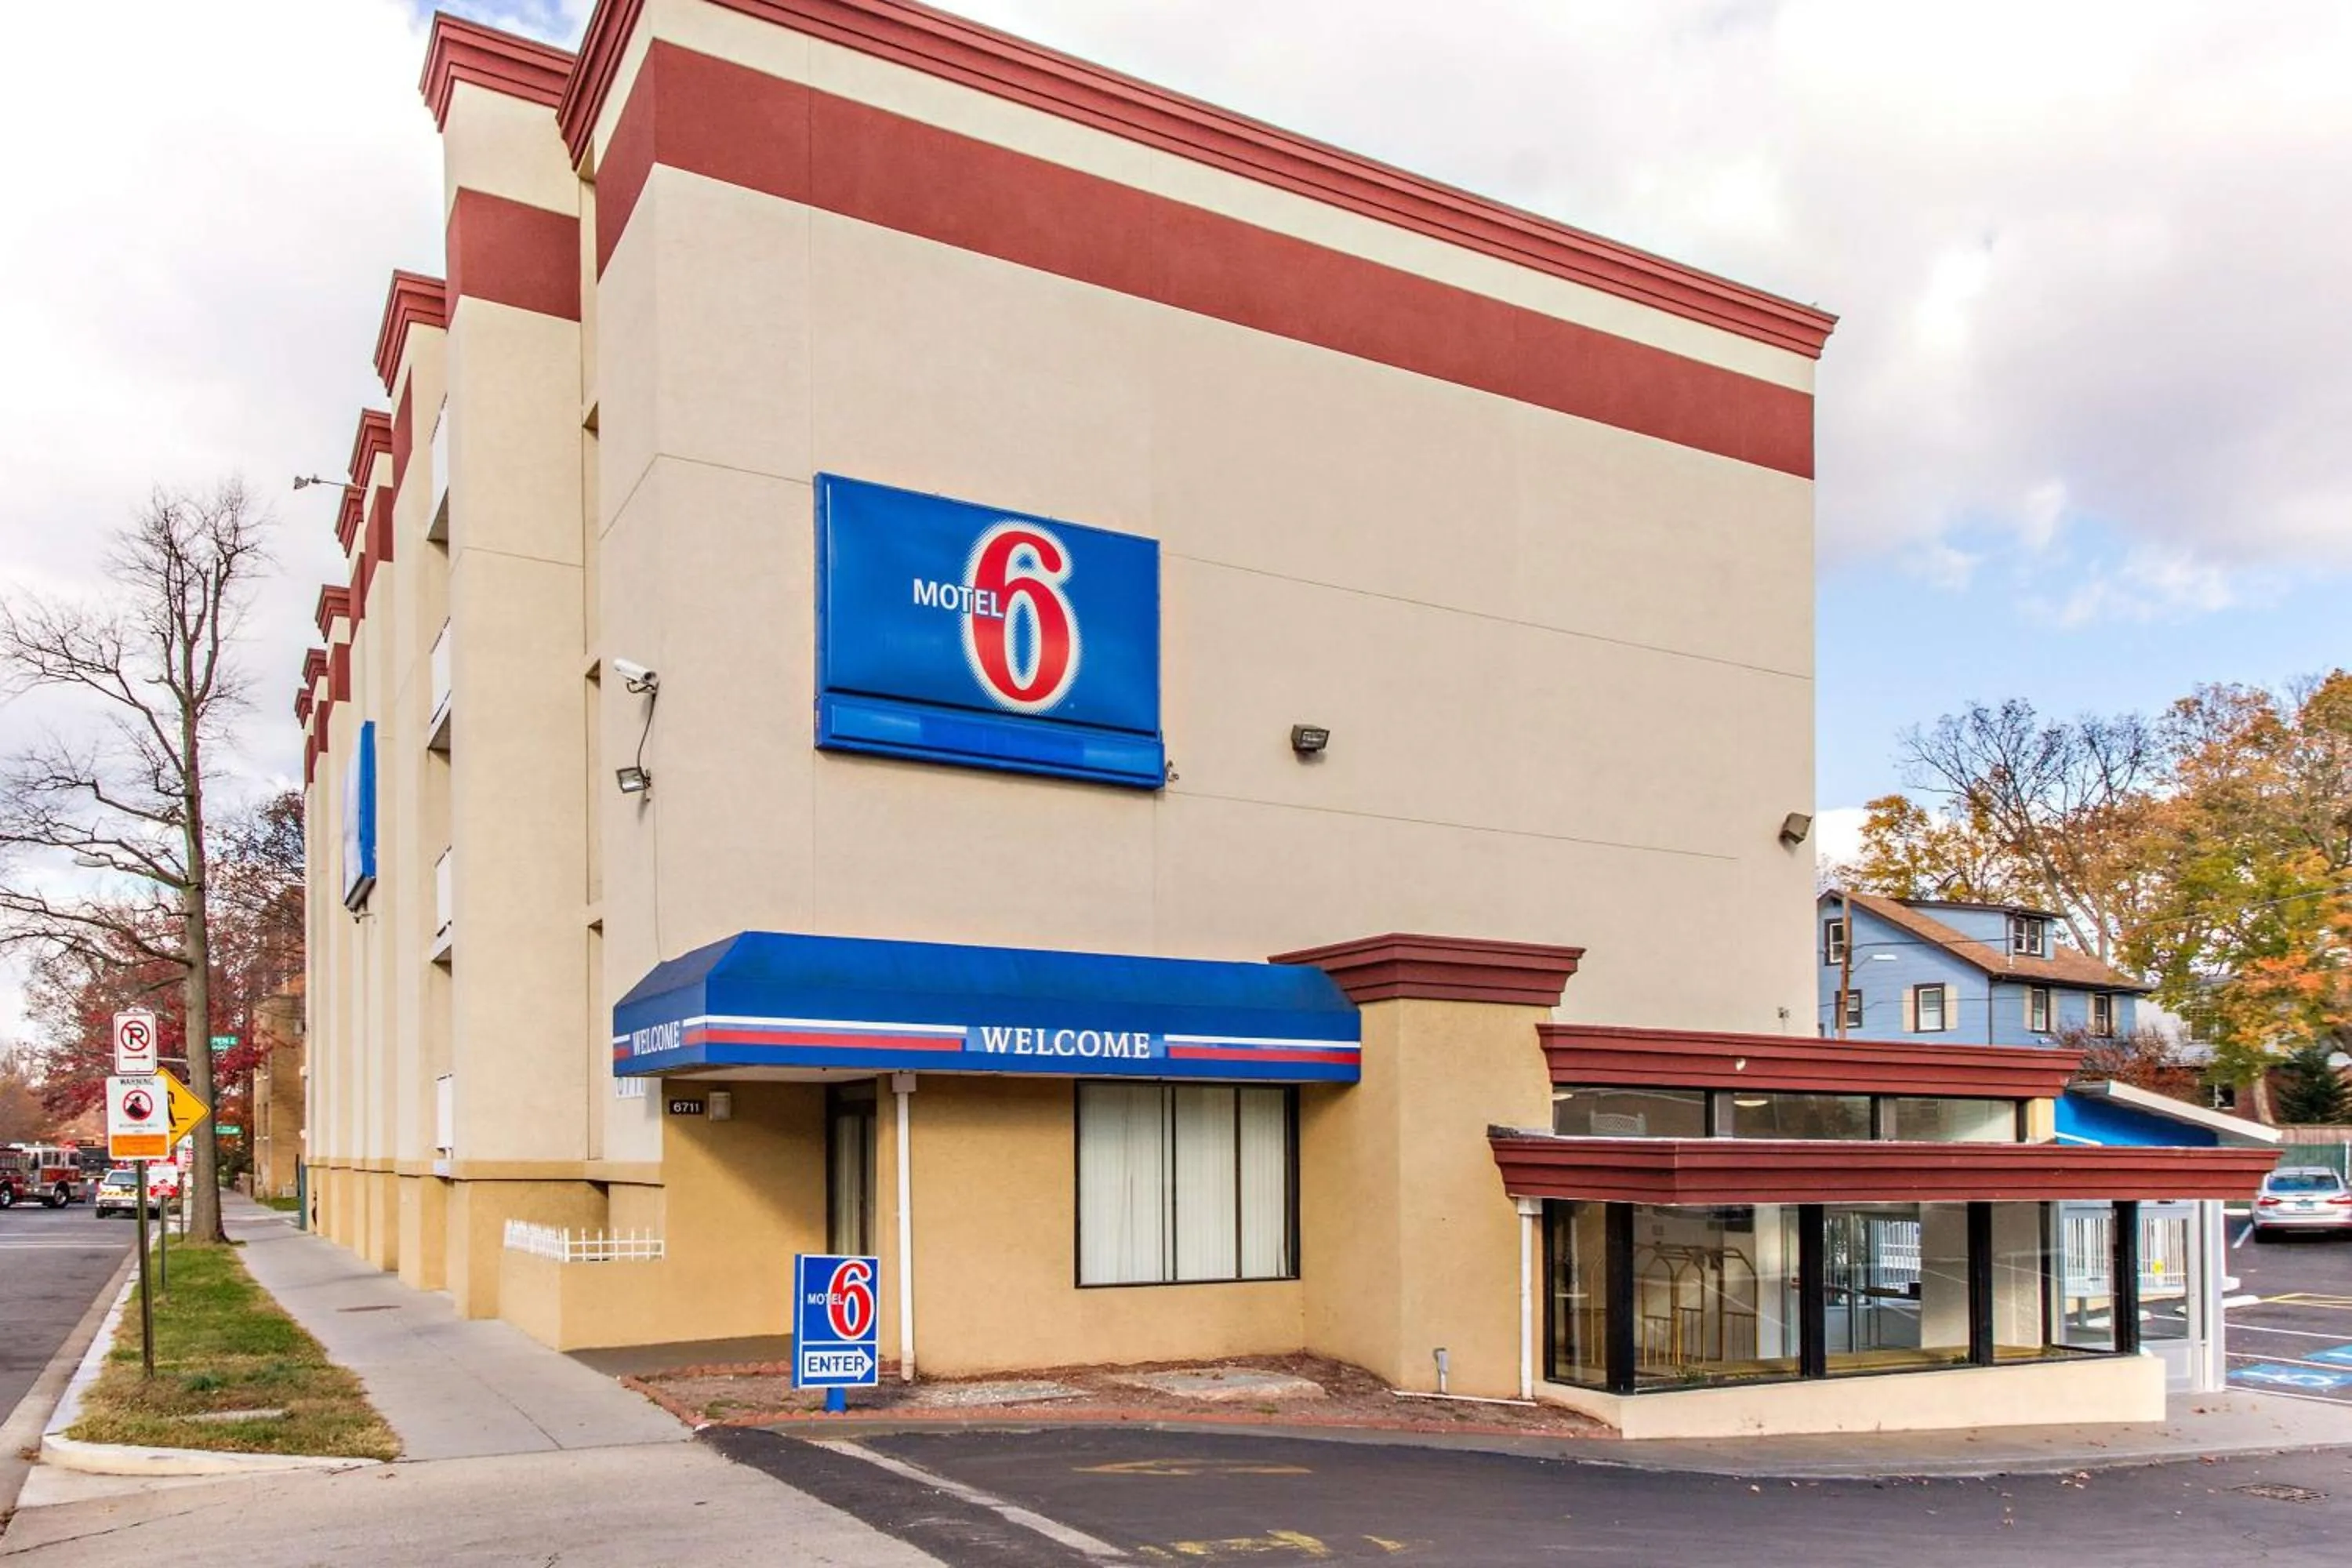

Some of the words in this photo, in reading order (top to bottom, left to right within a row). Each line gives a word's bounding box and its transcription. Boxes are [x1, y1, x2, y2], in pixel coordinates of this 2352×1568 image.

[913, 578, 1004, 619] MOTEL
[969, 527, 1075, 707] 6
[633, 1021, 680, 1056] WELCOME
[980, 1025, 1151, 1059] WELCOME
[673, 1102, 699, 1112] 6711
[807, 1292, 844, 1305] MOTEL
[827, 1259, 875, 1341] 6
[808, 1355, 865, 1373] ENTER
